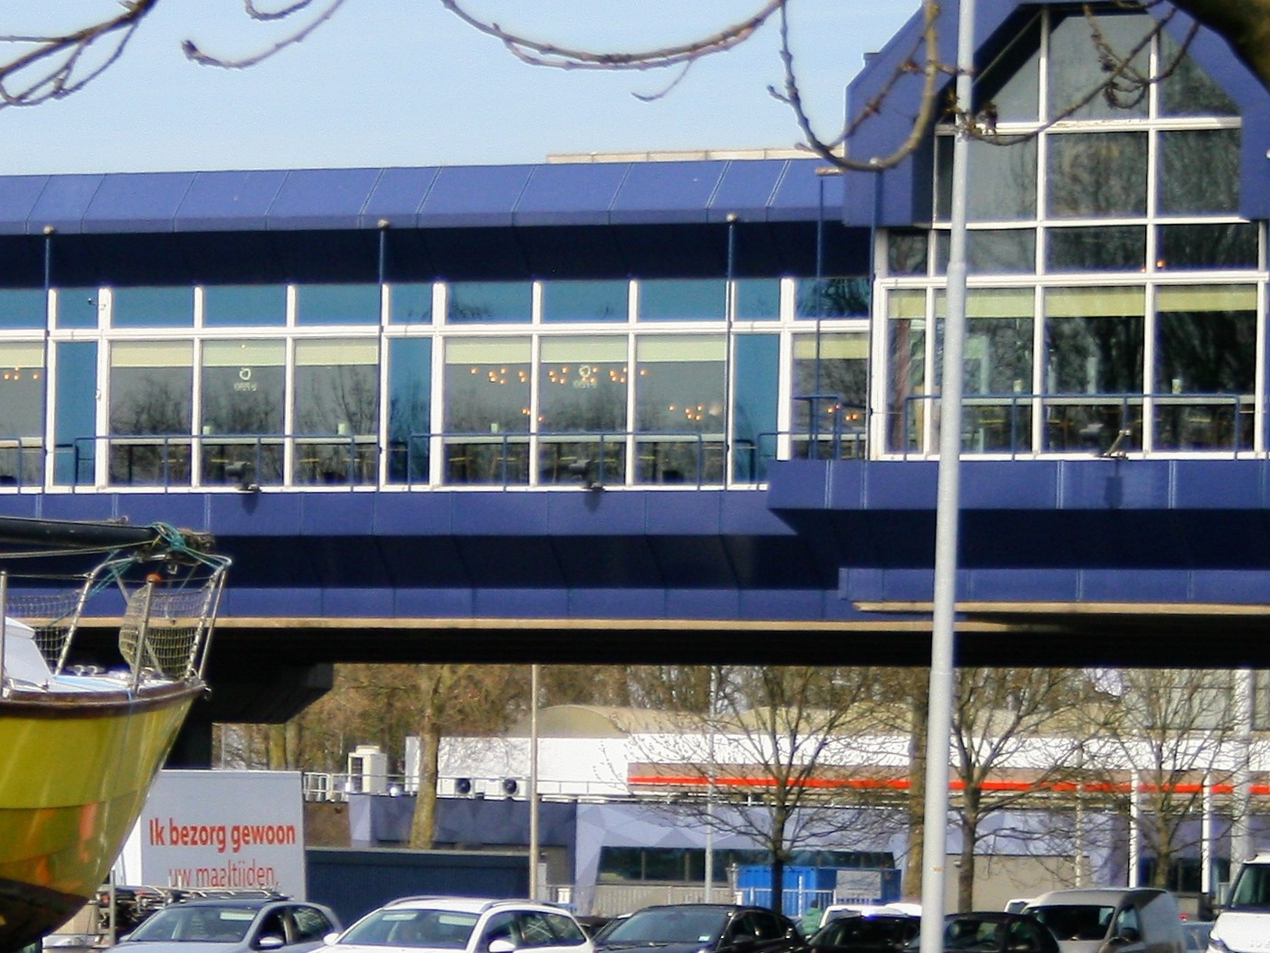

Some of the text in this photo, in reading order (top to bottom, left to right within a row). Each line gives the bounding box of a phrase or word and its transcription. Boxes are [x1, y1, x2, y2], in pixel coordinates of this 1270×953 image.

[149, 817, 296, 853] Ik bezorg gewoon
[168, 867, 191, 887] uw
